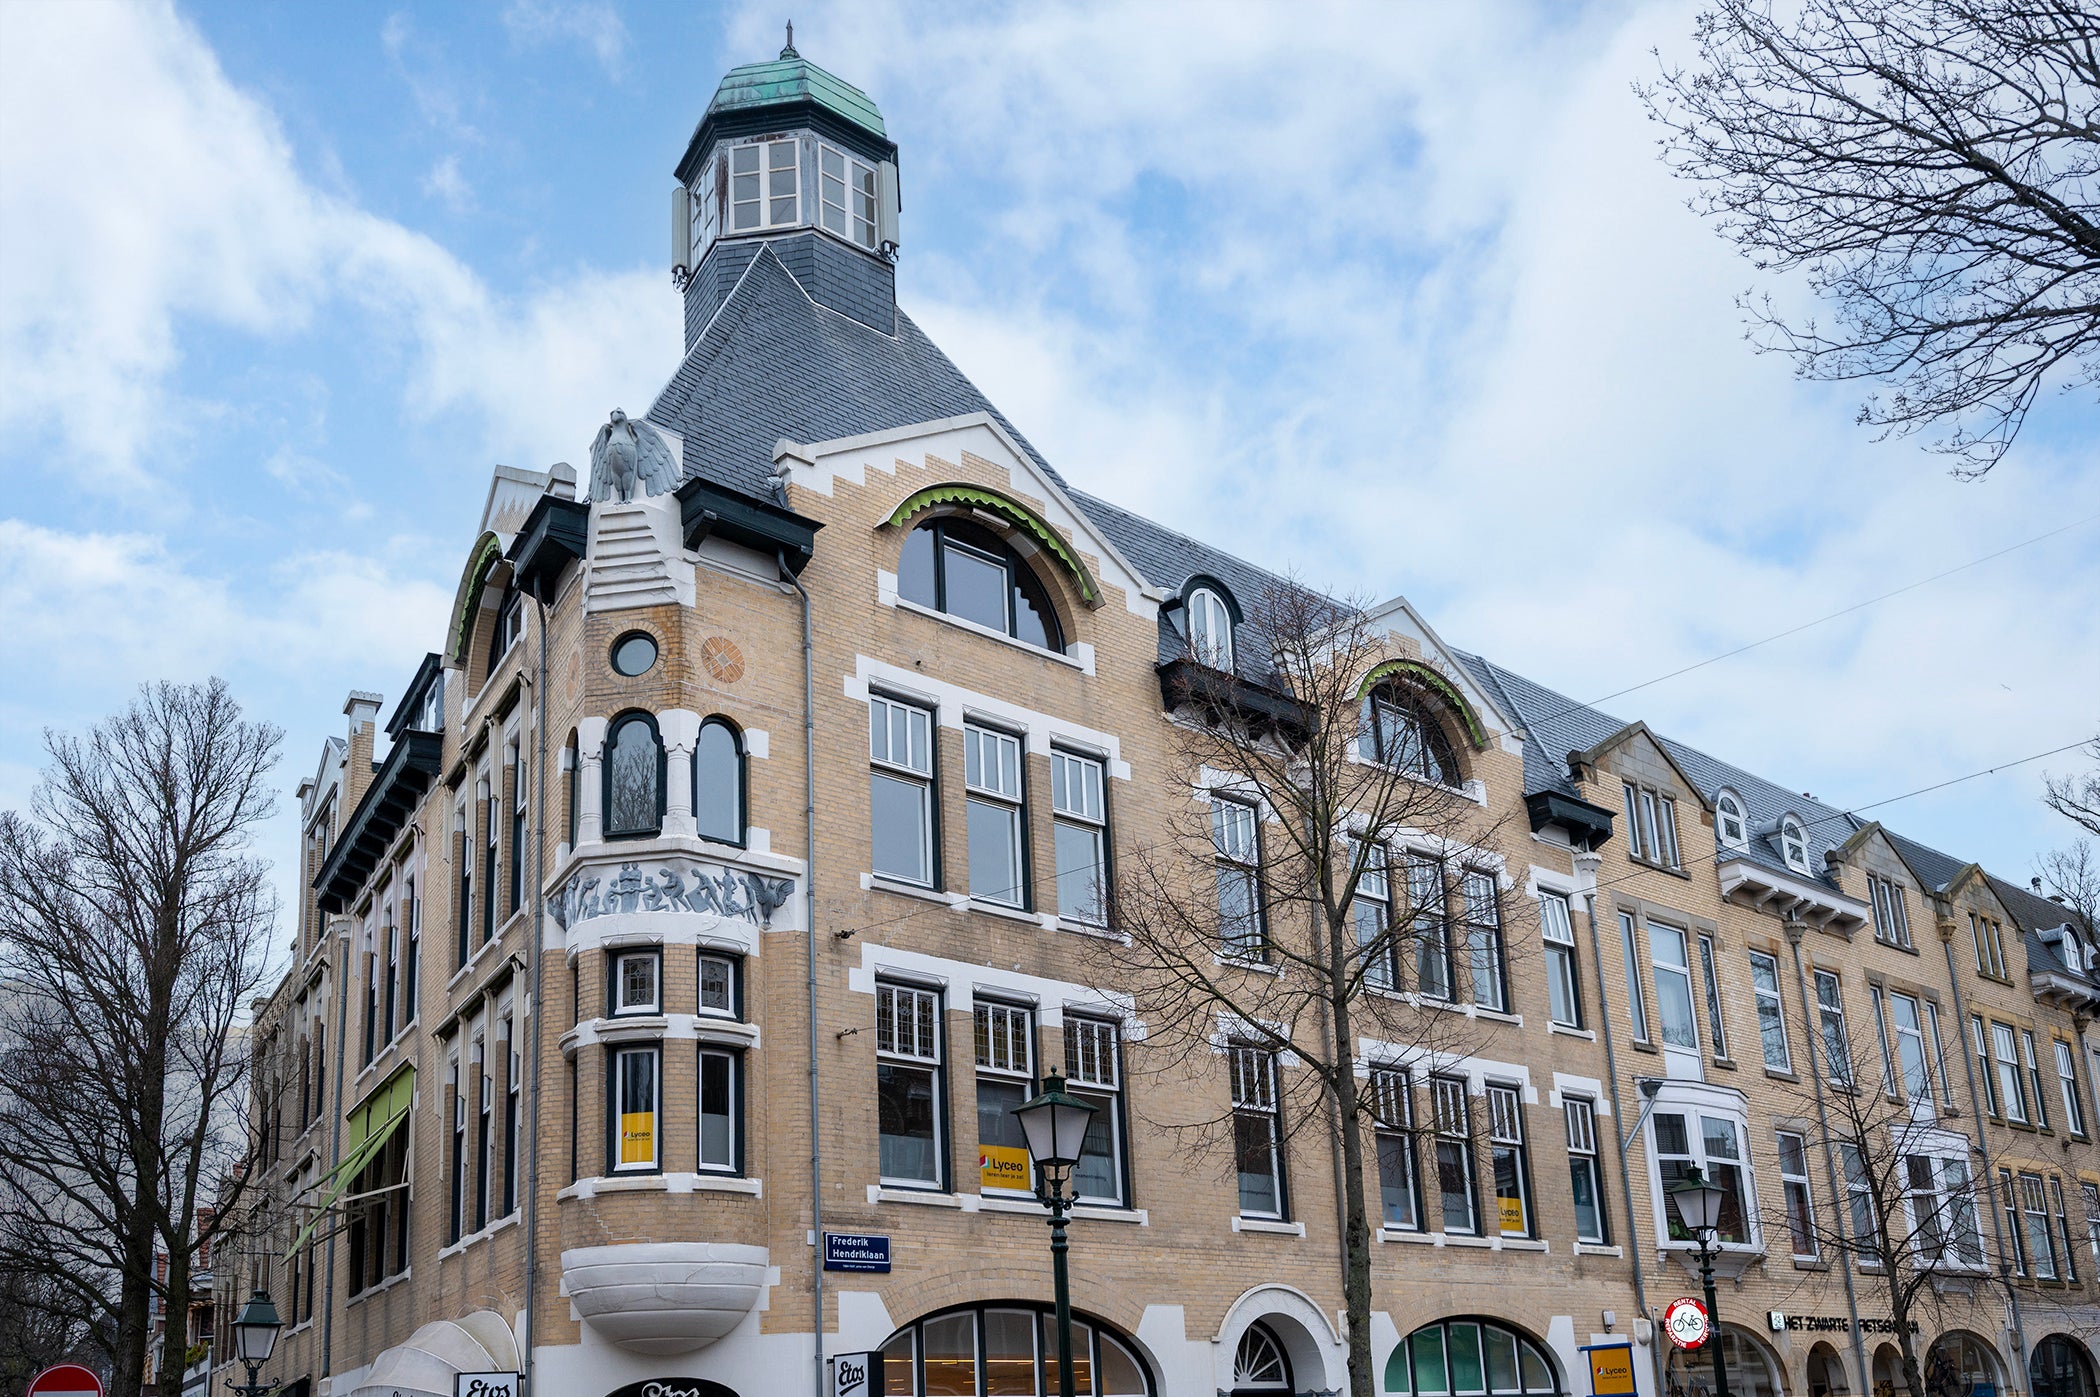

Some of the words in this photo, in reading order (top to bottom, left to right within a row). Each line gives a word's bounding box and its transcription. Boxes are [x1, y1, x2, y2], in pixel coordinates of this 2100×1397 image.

[992, 1158, 1023, 1172] Lyceo
[832, 1236, 869, 1247] Frederik
[832, 1248, 885, 1260] Hendriklaan
[1673, 1298, 1697, 1308] RENTAL
[1785, 1316, 1804, 1331] HET
[1806, 1316, 1849, 1332] ZWARTE
[838, 1361, 865, 1386] Etos
[1605, 1367, 1627, 1376] Lyceo
[466, 1379, 511, 1397] Etos
